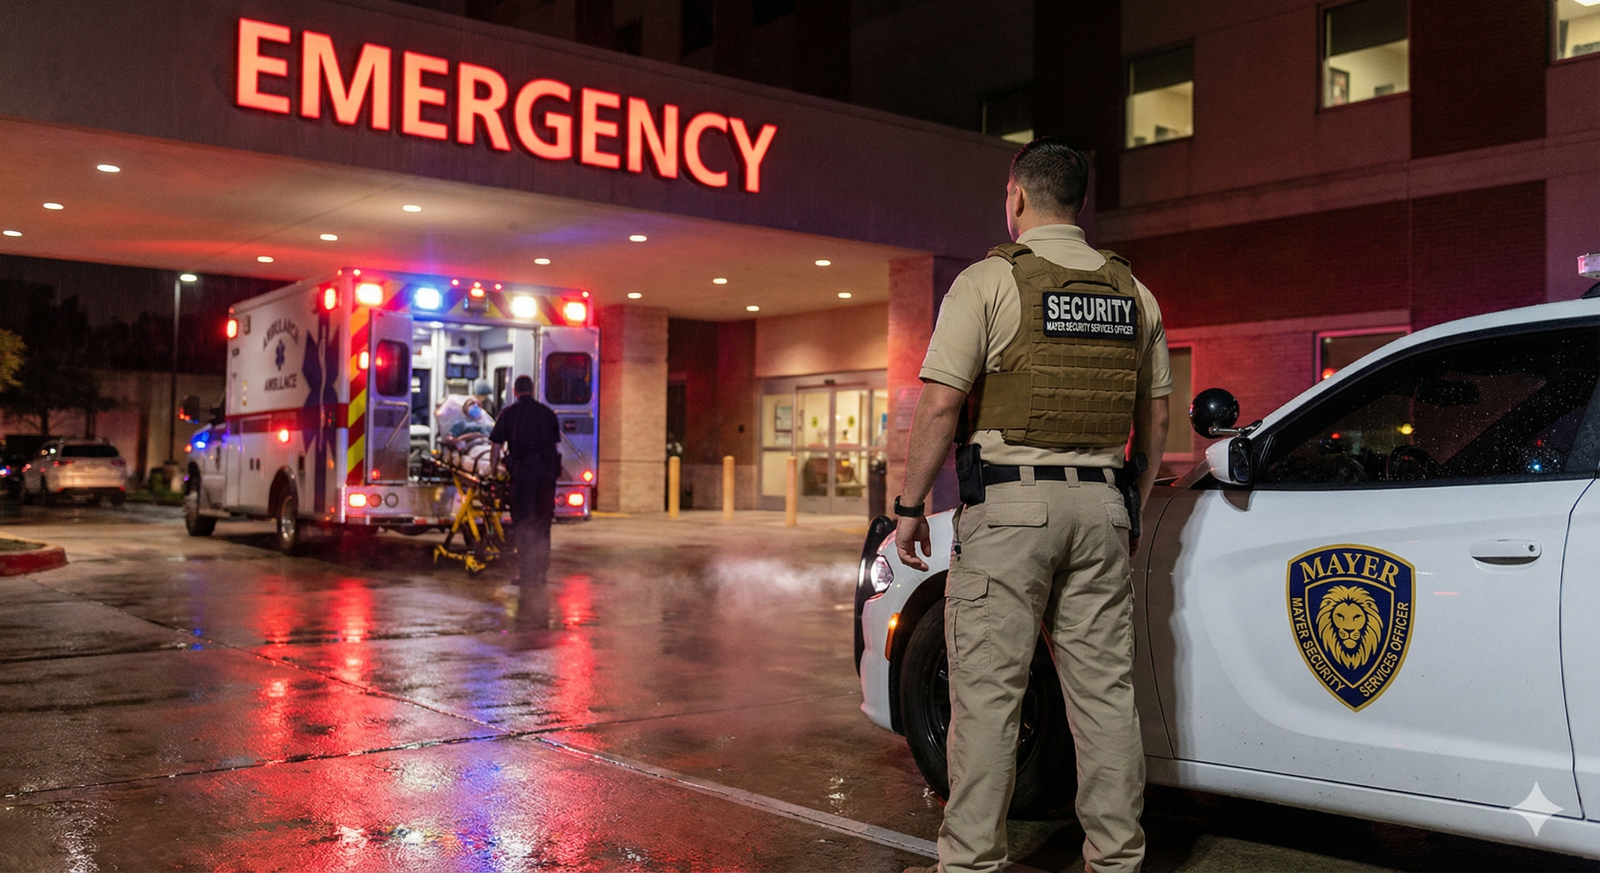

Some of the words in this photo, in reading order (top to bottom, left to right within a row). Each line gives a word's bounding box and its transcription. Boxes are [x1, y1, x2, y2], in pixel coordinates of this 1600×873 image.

[236, 17, 778, 194] EMERGENCY
[1047, 295, 1132, 323] SECURITY
[1299, 552, 1400, 588] MAYER
[1292, 597, 1310, 639] MAYER
[1302, 640, 1346, 692] SECURITY
[1359, 651, 1398, 697] SERVICES
[1390, 602, 1409, 651] OFFICER
